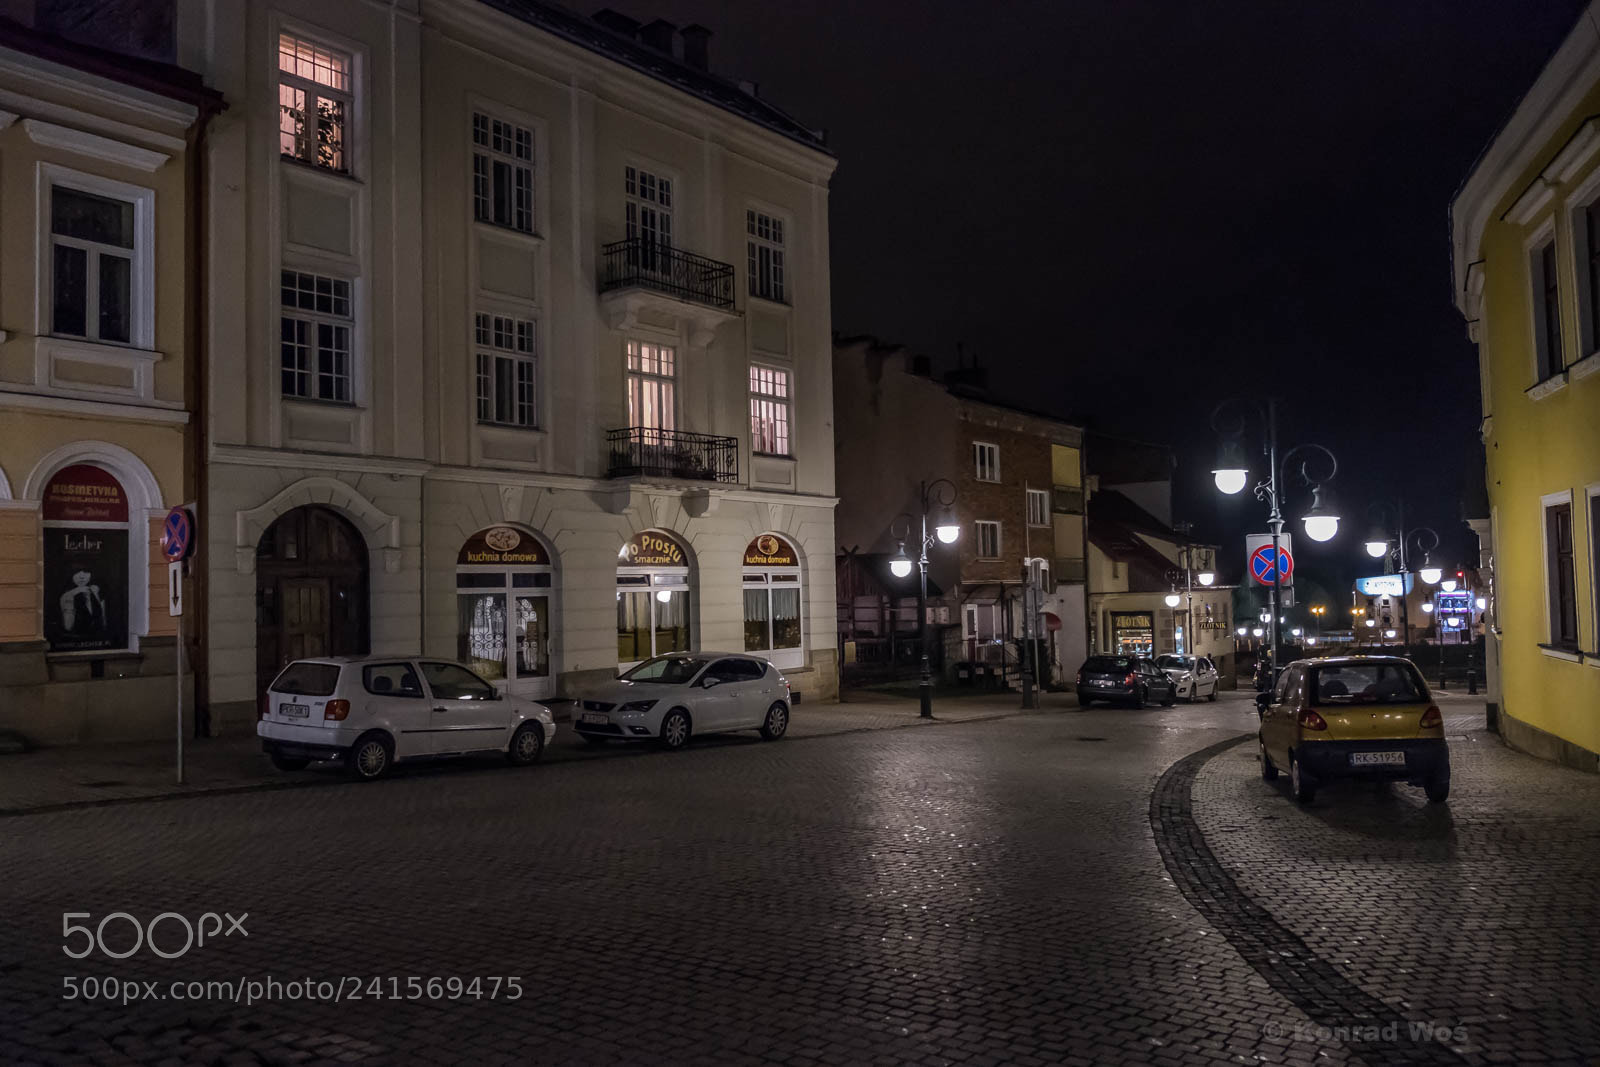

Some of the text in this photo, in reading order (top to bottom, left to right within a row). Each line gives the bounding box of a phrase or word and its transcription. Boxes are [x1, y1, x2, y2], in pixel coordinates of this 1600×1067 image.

[642, 535, 682, 562] Prostu
[467, 551, 537, 562] kuchnia domowa
[634, 555, 671, 564] smacznie
[746, 554, 791, 564] kuchnia domowa
